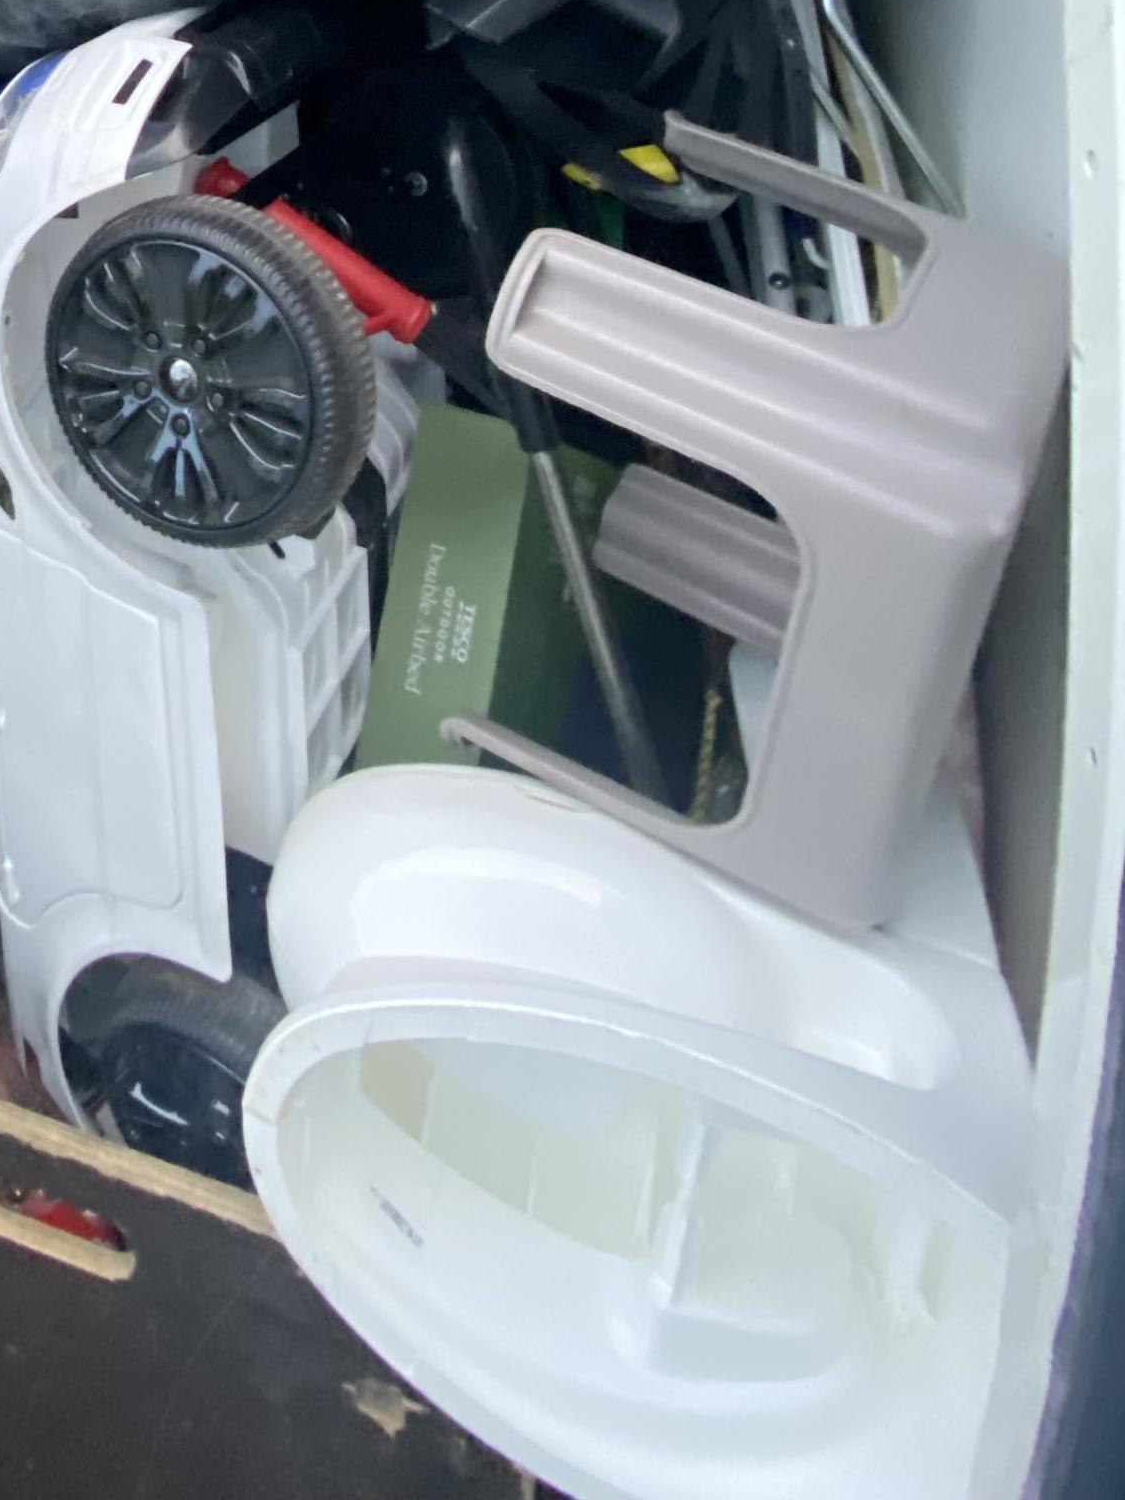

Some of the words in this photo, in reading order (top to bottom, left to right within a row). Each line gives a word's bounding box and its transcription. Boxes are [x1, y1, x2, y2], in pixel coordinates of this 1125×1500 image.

[418, 543, 446, 616] Double
[404, 619, 431, 694] Airbed
[434, 586, 456, 663] OUTDOOR
[455, 602, 476, 663] TESCO
